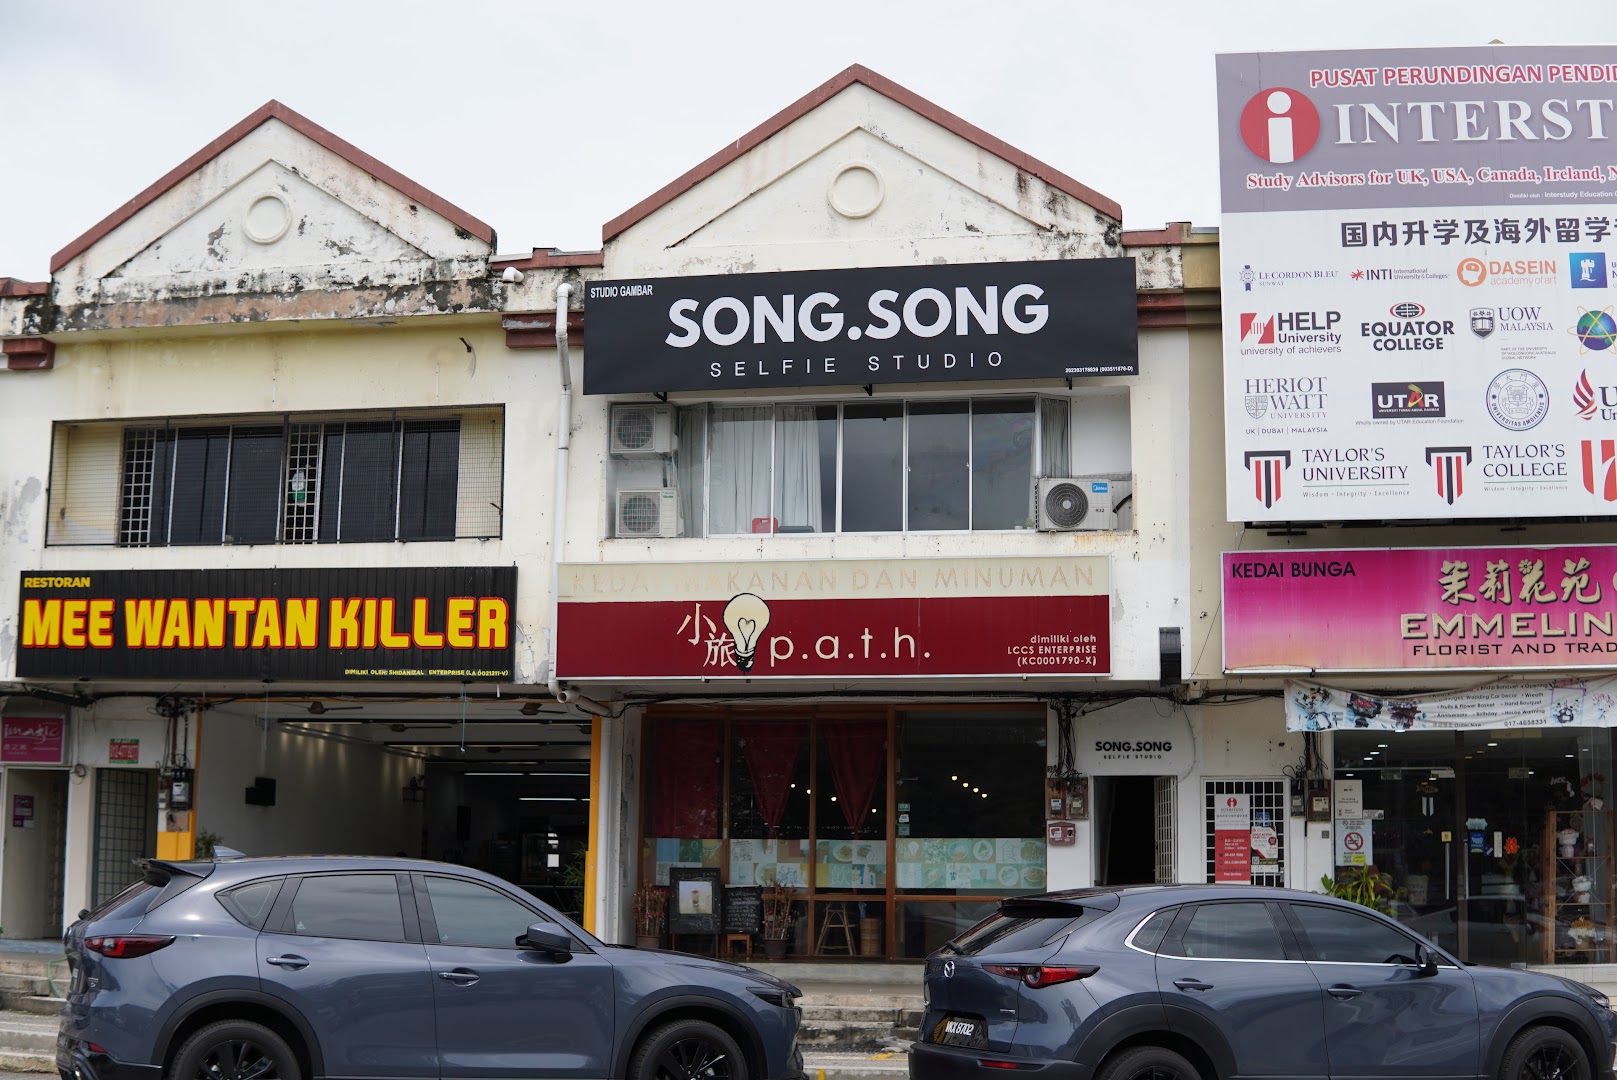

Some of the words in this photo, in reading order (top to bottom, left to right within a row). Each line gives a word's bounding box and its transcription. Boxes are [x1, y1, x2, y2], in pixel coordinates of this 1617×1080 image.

[1310, 68, 1378, 87] PUSAT
[1383, 65, 1542, 84] PERUNDINGAN
[1332, 99, 1613, 145] INTERST
[1247, 173, 1293, 191] Study
[1296, 171, 1365, 188] Advisors
[1368, 170, 1392, 185] for
[1396, 169, 1429, 186] UK,
[1431, 168, 1474, 185] USA,
[1477, 167, 1541, 184] Canada,
[1544, 166, 1606, 183] Ireland,
[1544, 192, 1578, 200] Interstudy
[1580, 190, 1612, 198] Education
[1341, 216, 1617, 248] 国内升学及海外留学
[1259, 272, 1270, 280] LE
[1271, 271, 1312, 280] CORDON
[1314, 270, 1338, 279] BLEU
[1366, 269, 1392, 280] INTI
[1489, 260, 1556, 275] DASEIN
[1490, 276, 1534, 287] academy
[1534, 276, 1544, 285] of
[1545, 276, 1556, 285] art
[590, 286, 618, 299] STUDIO
[620, 284, 653, 298] GAMBAR
[664, 284, 1050, 348] SONG.SONG
[1278, 311, 1342, 331] HELP
[1498, 307, 1542, 320] UOW
[1361, 320, 1455, 338] EQUATOR
[1500, 322, 1554, 332] MALAYSIA
[1278, 332, 1342, 345] University
[1372, 338, 1444, 351] COLLEGE
[1240, 346, 1283, 357] university
[1285, 346, 1294, 354] of
[1296, 344, 1342, 354] achievers
[710, 358, 836, 378] SELFIE
[868, 352, 1002, 372] STUDIO
[1245, 377, 1328, 394] HERIOT
[1270, 394, 1328, 410] WATT
[1378, 390, 1440, 408] UTAR
[1270, 412, 1328, 420] UNIVERSITY
[1491, 402, 1522, 427] UNIVERSITAS
[1292, 426, 1328, 434] MALAYSIA
[1302, 448, 1385, 462] TAYLOR'S
[1483, 444, 1565, 458] TAYLOR'S
[1303, 466, 1408, 482] UNIVERSITY
[1484, 462, 1568, 478] COLLEGE
[1336, 490, 1367, 498] Integrity
[852, 568, 917, 590] DAN
[934, 565, 1094, 589] MINUMAN
[1232, 562, 1284, 579] KEDAI
[1291, 561, 1356, 578] BUNGA
[24, 576, 91, 589] RESTORAN
[1438, 556, 1602, 606] 茉莉花苑
[22, 598, 116, 648] MEE
[124, 598, 320, 650] WANTAN
[328, 597, 509, 650] KILLER
[1401, 611, 1613, 640] EMMELIN
[770, 626, 931, 667] p.a.t.h.
[1030, 635, 1069, 644] dimiliki
[1073, 634, 1096, 643] oleh
[1008, 646, 1034, 654] LCCS
[1038, 645, 1096, 654] ENTERPRISE
[1413, 644, 1503, 656] FLORIST
[1511, 643, 1556, 654] AND
[1018, 656, 1096, 668] (KC0001790-X)
[1096, 742, 1172, 752] SONG.SONG
